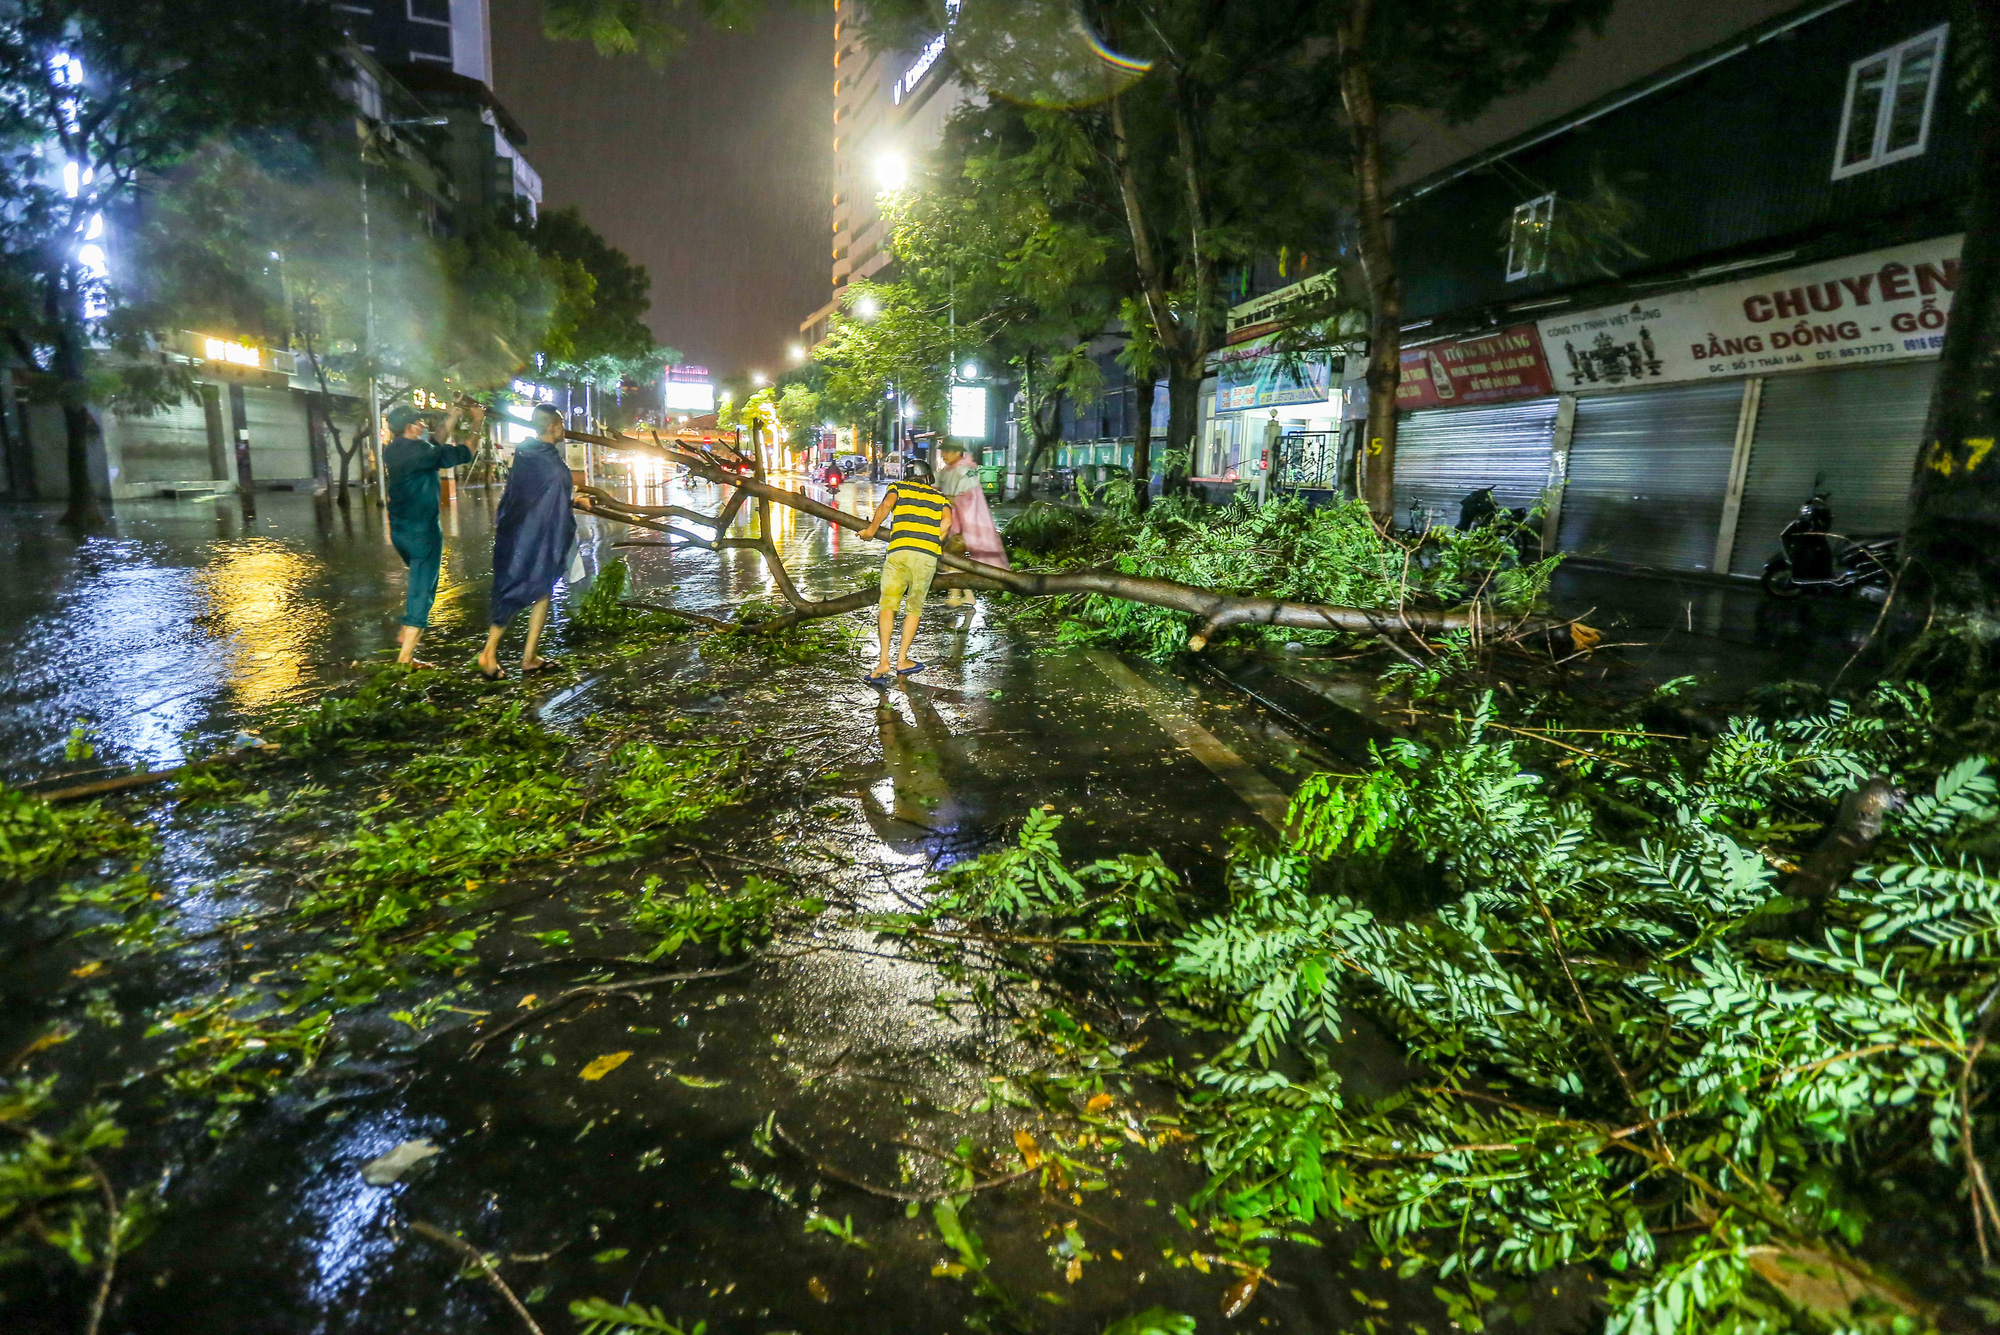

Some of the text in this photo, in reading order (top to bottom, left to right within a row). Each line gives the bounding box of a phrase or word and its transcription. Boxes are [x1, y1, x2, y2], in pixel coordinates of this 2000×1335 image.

[1547, 326, 1570, 338] CÔNG
[1572, 323, 1583, 333] TY
[1691, 332, 1764, 360] BẰNG
[1748, 360, 1755, 368] 7
